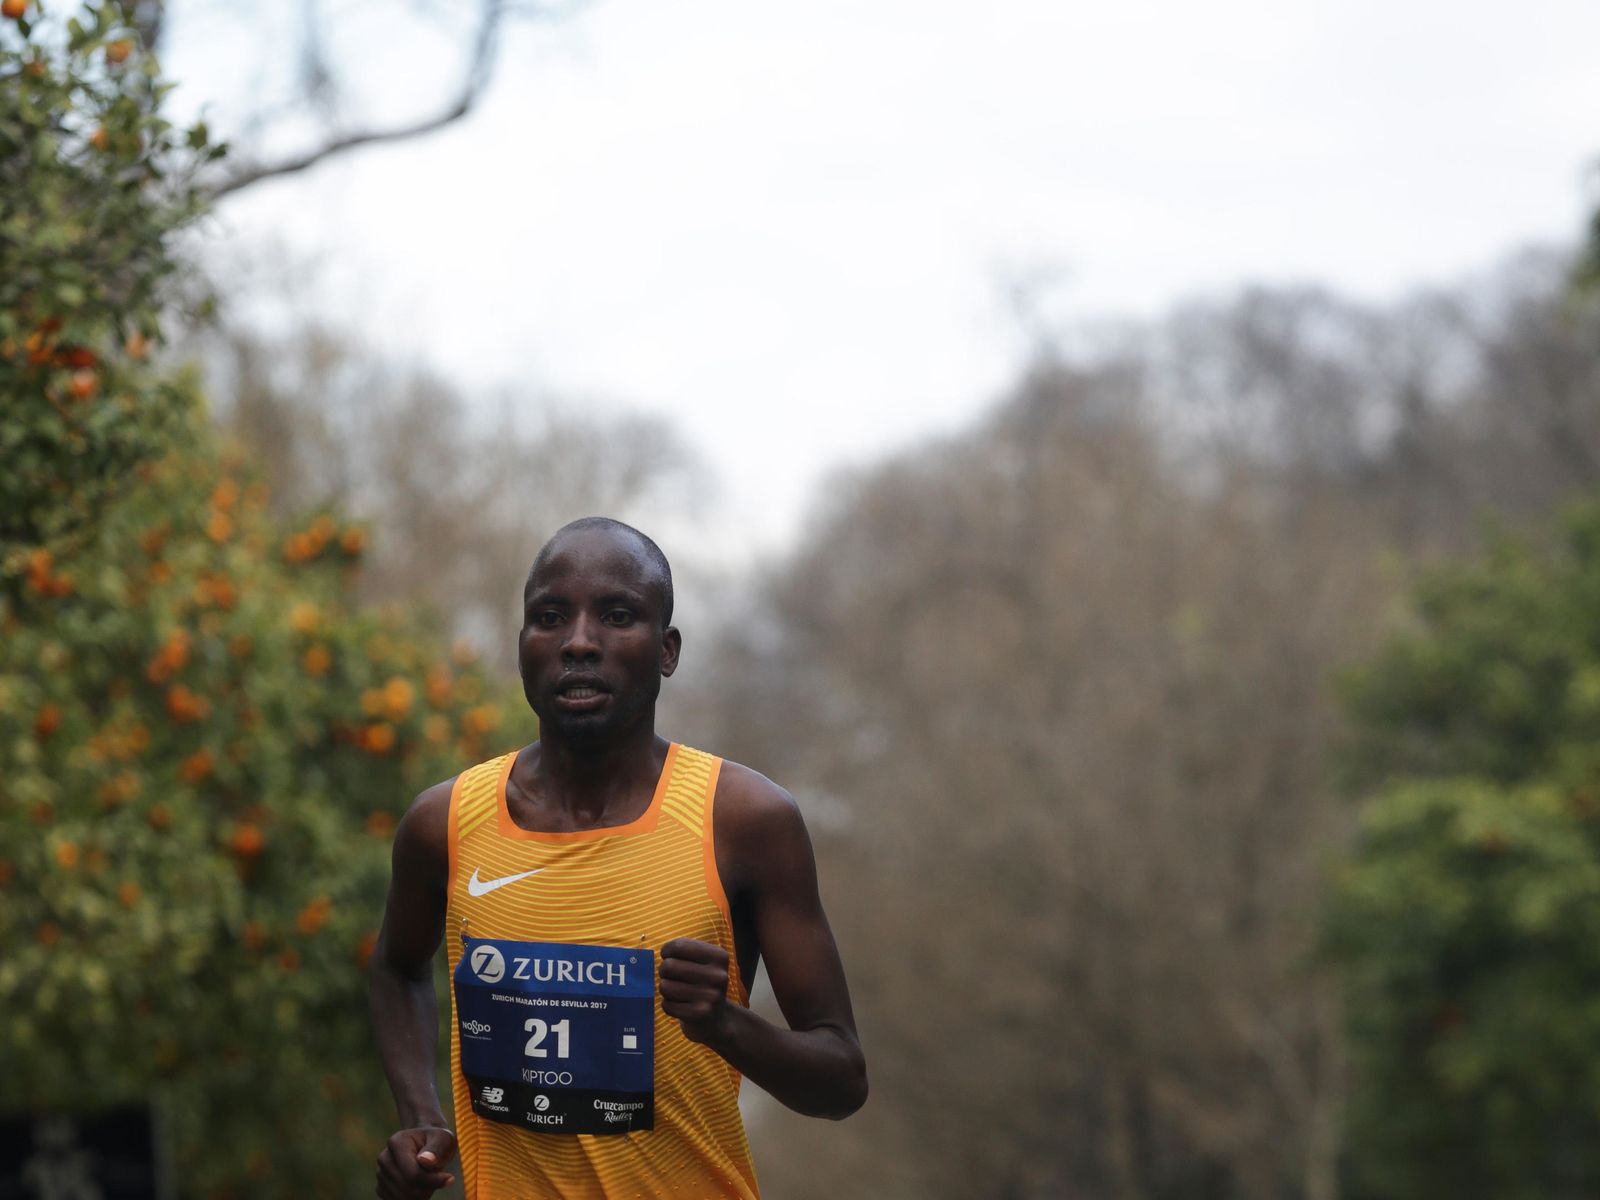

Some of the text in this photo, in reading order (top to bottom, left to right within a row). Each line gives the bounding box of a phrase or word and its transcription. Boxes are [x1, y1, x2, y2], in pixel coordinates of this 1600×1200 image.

[512, 957, 626, 986] ZURICH
[491, 993, 608, 1010] ZURICH MARATÓN DE SEVILLA 2017
[524, 1018, 570, 1059] 21
[521, 1067, 573, 1085] KIPTOO
[593, 1099, 644, 1111] Cruzcampo
[526, 1112, 564, 1125] ZURICH
